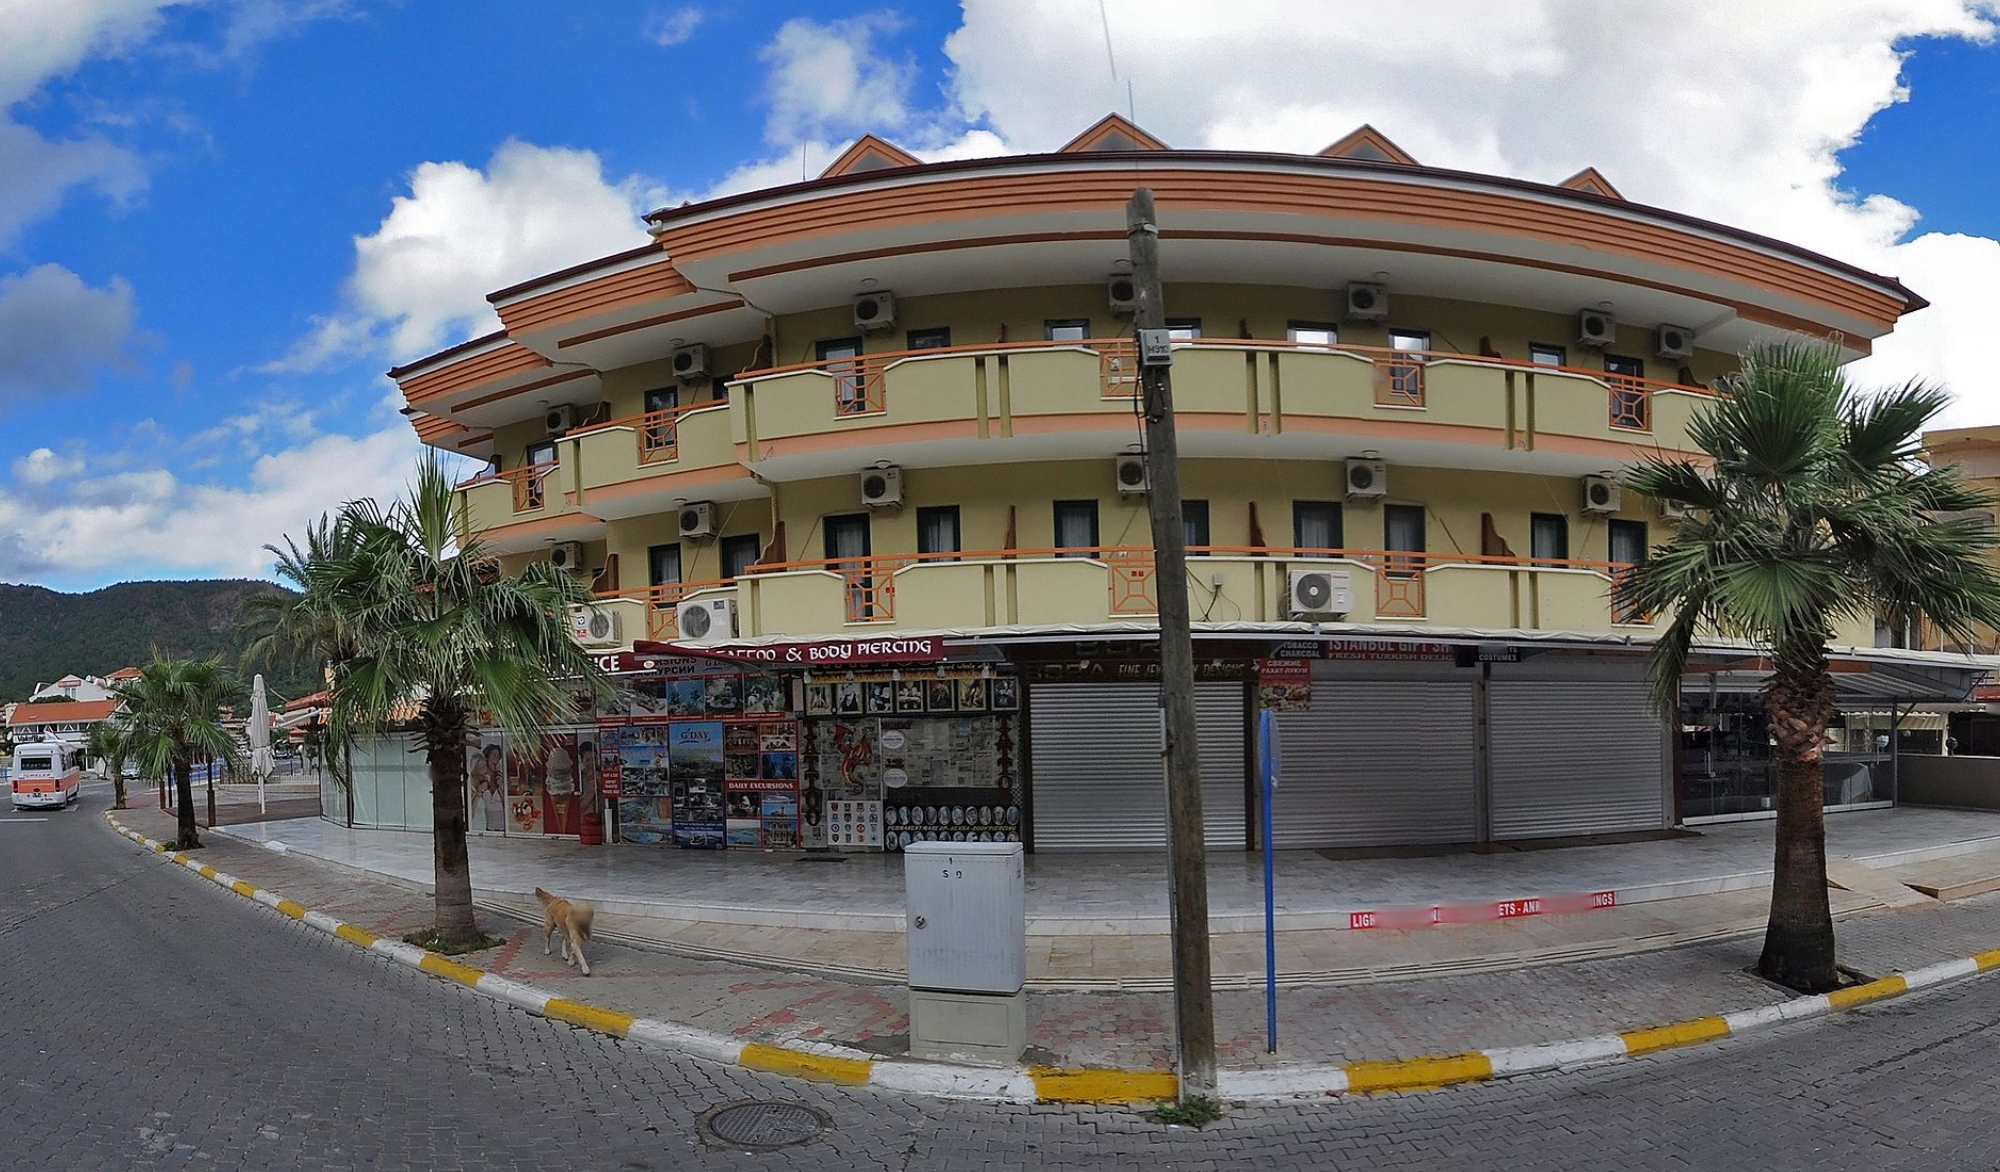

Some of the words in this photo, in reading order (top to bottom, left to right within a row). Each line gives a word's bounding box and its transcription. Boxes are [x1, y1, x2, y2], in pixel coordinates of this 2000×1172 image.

[786, 647, 802, 661] &
[809, 644, 851, 660] BODY
[857, 640, 931, 655] PIERCING
[1329, 640, 1394, 652] ISTANBUL
[1280, 650, 1321, 658] CHARCOAL
[1328, 652, 1366, 660] FRESH
[1369, 652, 1417, 660] TURKISH
